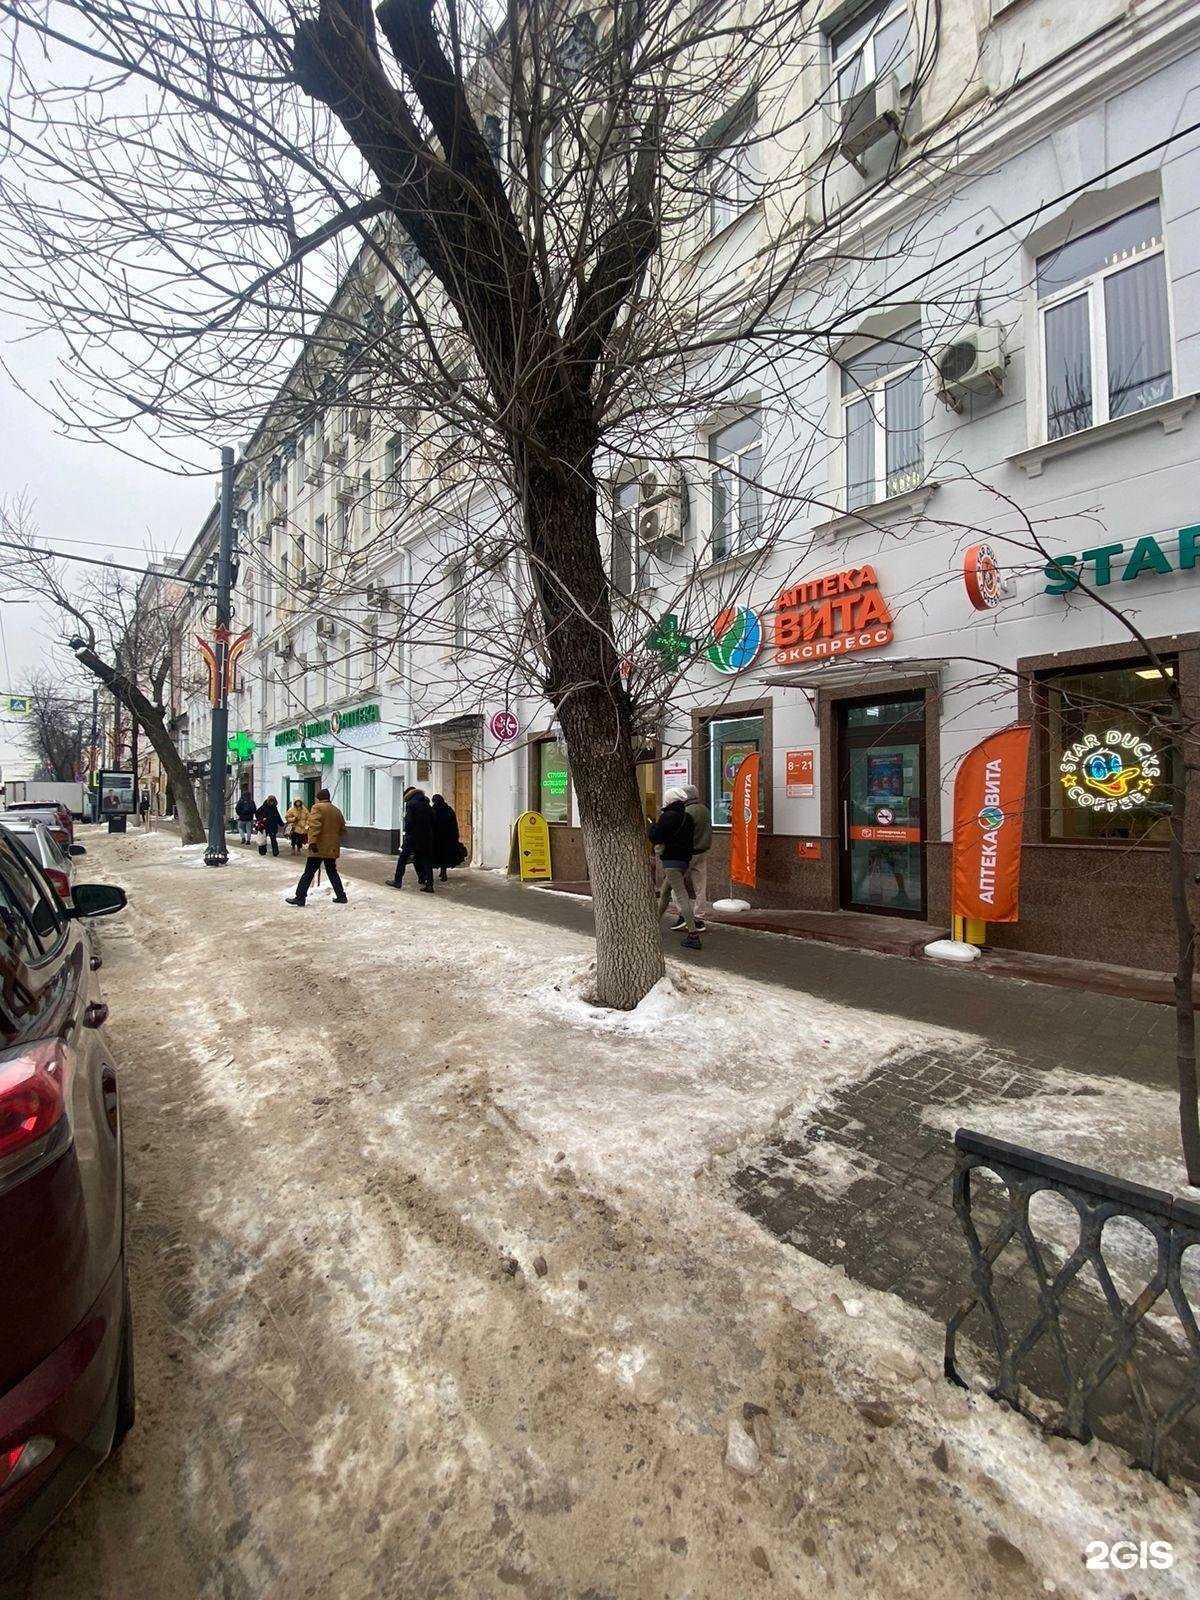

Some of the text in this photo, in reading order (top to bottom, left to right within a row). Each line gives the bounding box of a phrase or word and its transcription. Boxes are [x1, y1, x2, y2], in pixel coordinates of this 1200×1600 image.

[776, 564, 878, 609] АПТЕКА
[774, 588, 893, 648] ВИТА
[776, 630, 888, 663] ЭКСПРЕСС
[1060, 730, 1160, 777] STAR DUCKS
[744, 773, 752, 807] ВИТА
[1068, 786, 1146, 812] COFFEE
[979, 758, 1002, 905] АПТЕКА ВИТА
